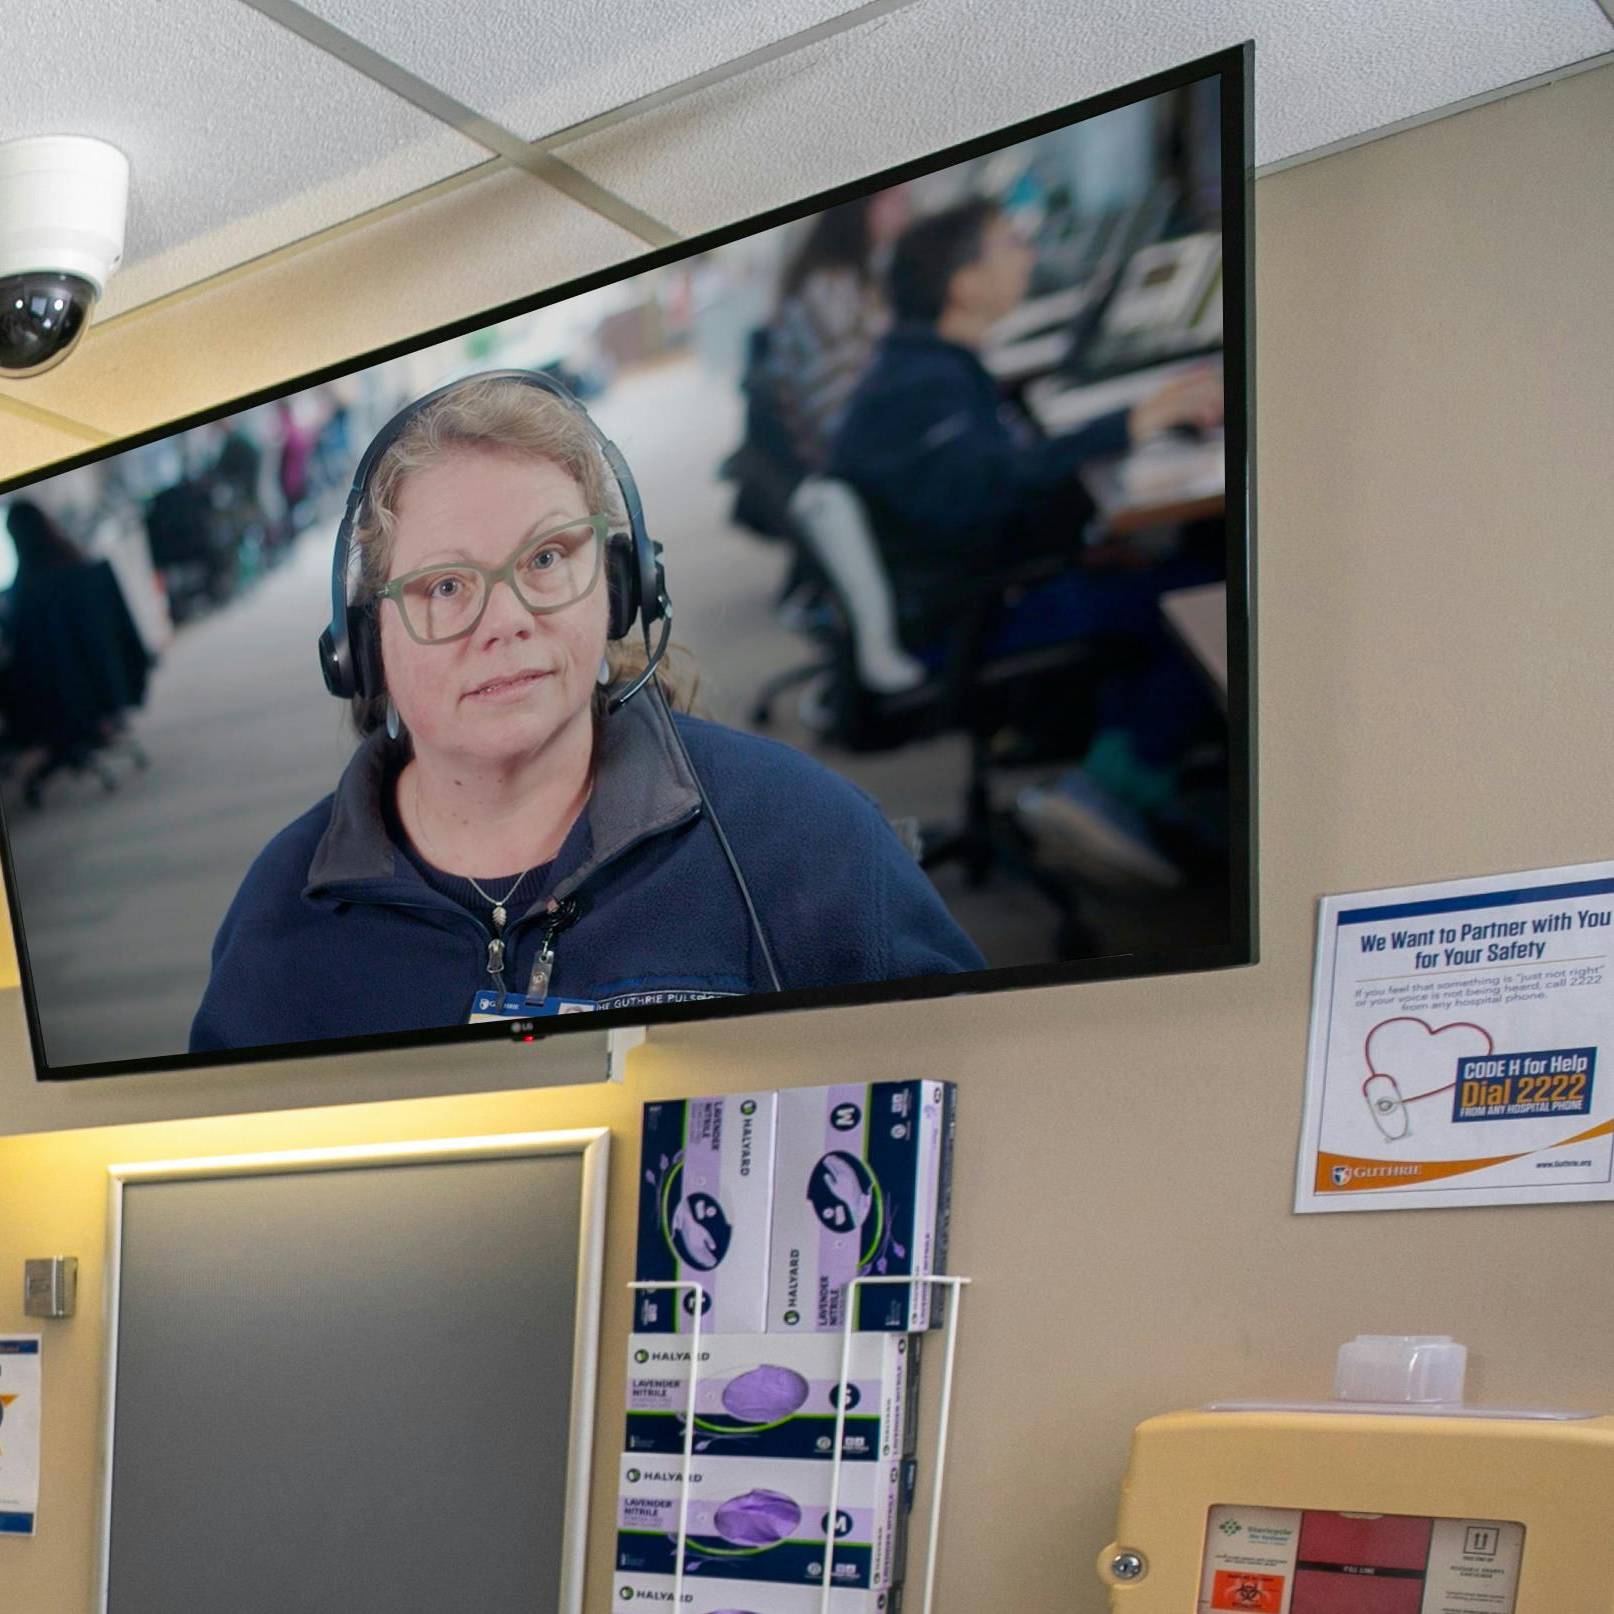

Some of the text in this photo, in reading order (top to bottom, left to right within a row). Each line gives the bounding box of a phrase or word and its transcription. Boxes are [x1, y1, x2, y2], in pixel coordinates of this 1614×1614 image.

[1361, 909, 1612, 953] We Want to Partner with You
[1415, 941, 1546, 970] for Your Safety
[1388, 985, 1410, 995] feel
[1412, 982, 1435, 992] that
[1436, 974, 1500, 989] something
[1503, 976, 1513, 984] is
[1545, 969, 1567, 979] not
[1443, 989, 1464, 999] not
[1465, 984, 1501, 998] being
[1545, 978, 1567, 989] call
[1570, 975, 1603, 987] 2222
[614, 994, 663, 1008] GUTHRIE
[1402, 1001, 1428, 1012] from
[1432, 1000, 1452, 1010] any
[1454, 994, 1502, 1008] hospital
[1464, 1054, 1588, 1080] CODE H for Help
[1460, 1073, 1586, 1108] Dial 2222
[1459, 1100, 1583, 1117] FROM ANY HOSPITAL PHONE
[740, 1119, 753, 1176] HALYARD
[788, 1249, 799, 1307] HALYARD
[632, 1380, 680, 1388] LAVENDER
[633, 1389, 667, 1397] NITRILE
[625, 1498, 673, 1508] LAVENDER
[625, 1508, 658, 1517] NITRILE
